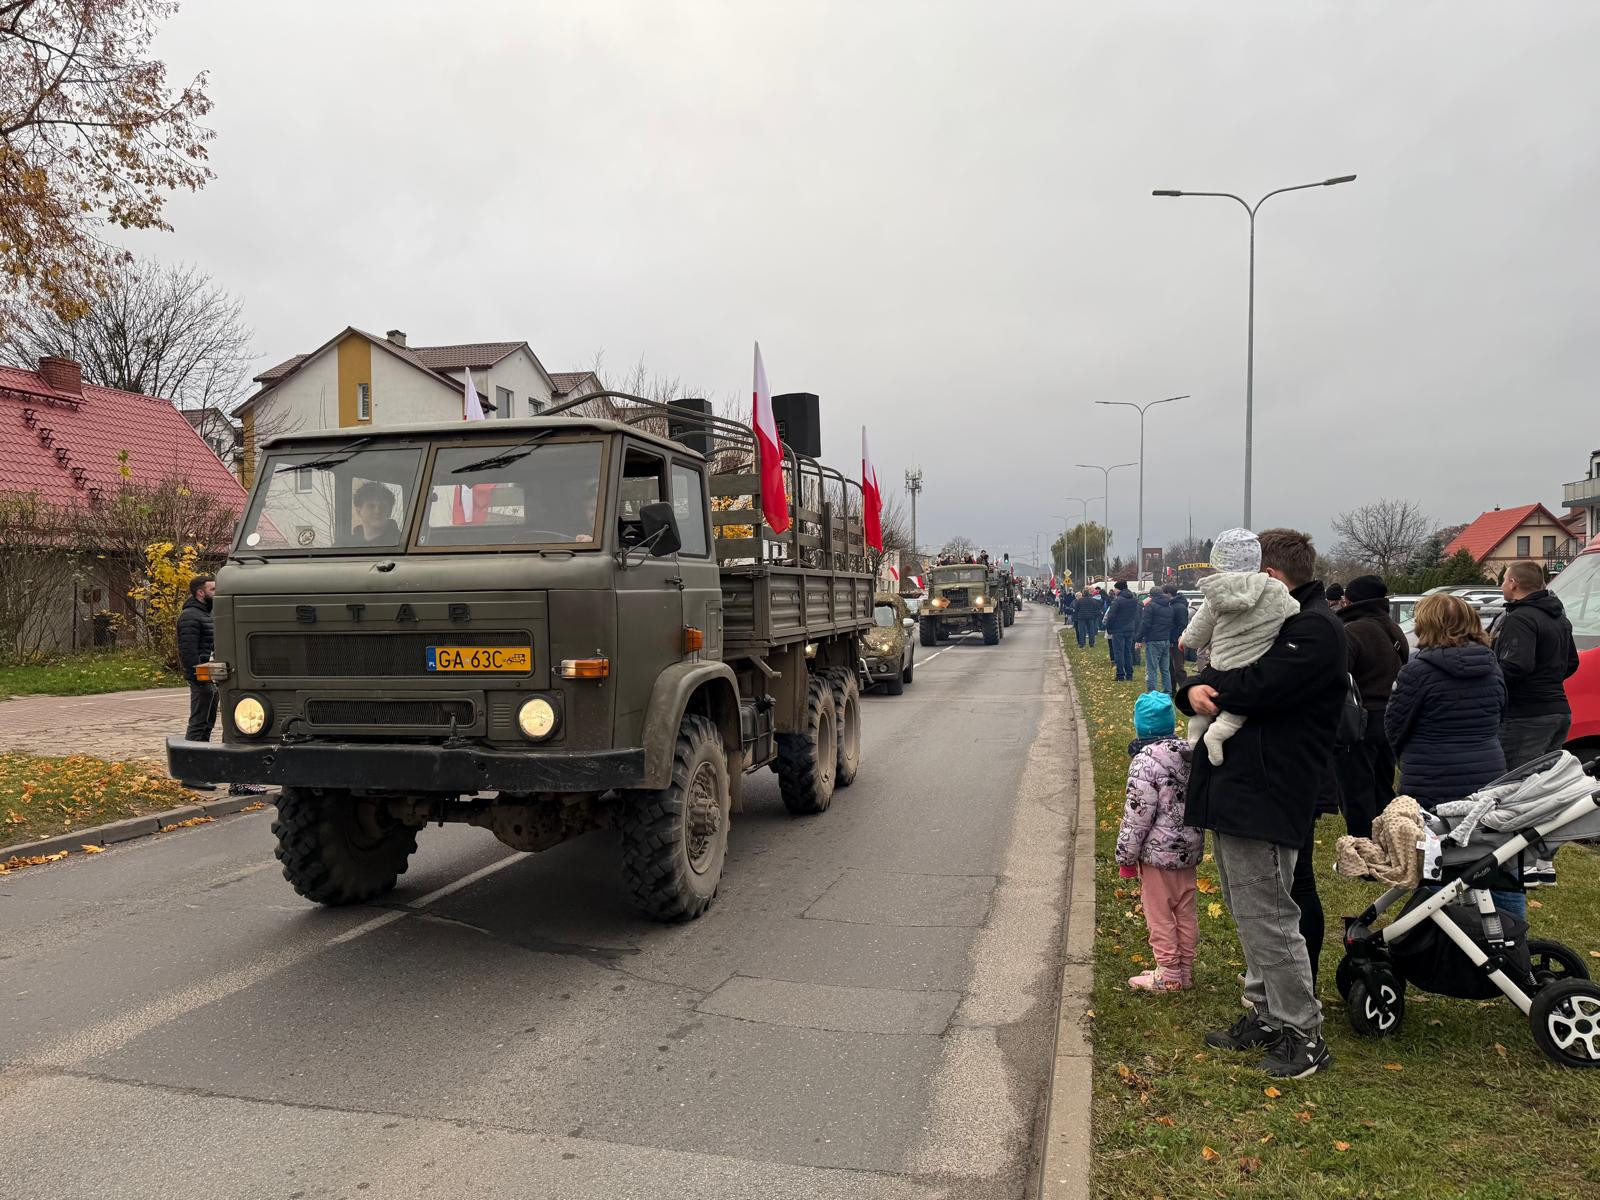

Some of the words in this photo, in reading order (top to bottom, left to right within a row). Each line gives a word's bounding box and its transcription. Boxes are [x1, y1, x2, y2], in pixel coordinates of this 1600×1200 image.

[295, 603, 471, 624] STAR
[439, 650, 464, 669] GA
[471, 650, 503, 669] 63C
